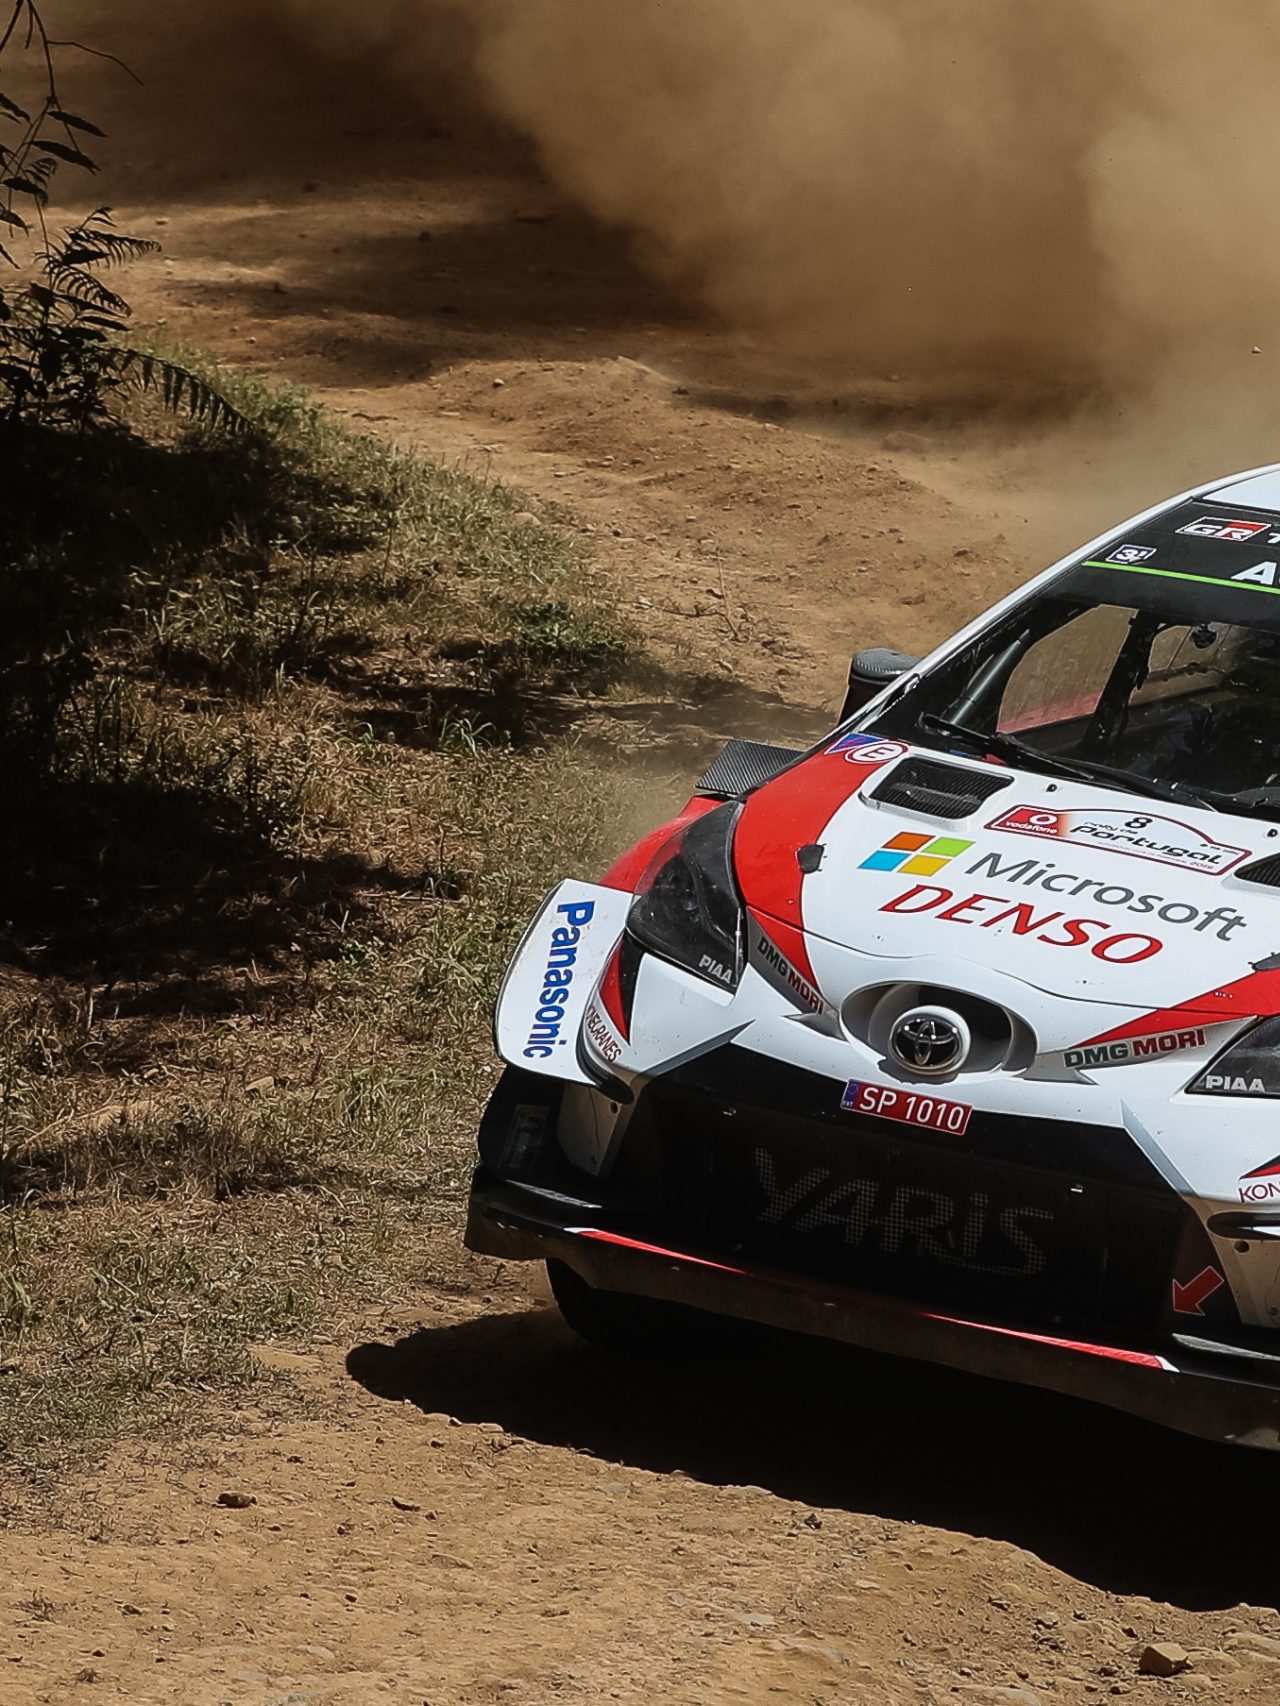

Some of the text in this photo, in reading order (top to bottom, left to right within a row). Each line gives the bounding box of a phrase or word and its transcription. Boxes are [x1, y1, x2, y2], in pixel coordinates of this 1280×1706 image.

[1182, 519, 1257, 541] GR
[1005, 820, 1059, 835] vodafone
[1124, 816, 1154, 830] 8
[964, 852, 1249, 942] Microsoft
[878, 884, 1163, 964] DENSO
[523, 901, 596, 1059] Panasonic
[699, 954, 733, 984] PIAA
[757, 936, 826, 1015] DMG MORI
[1064, 1029, 1206, 1068] DMG MORI
[1205, 1075, 1266, 1093] PIAA
[860, 1087, 897, 1113] SP
[905, 1096, 965, 1130] 1010
